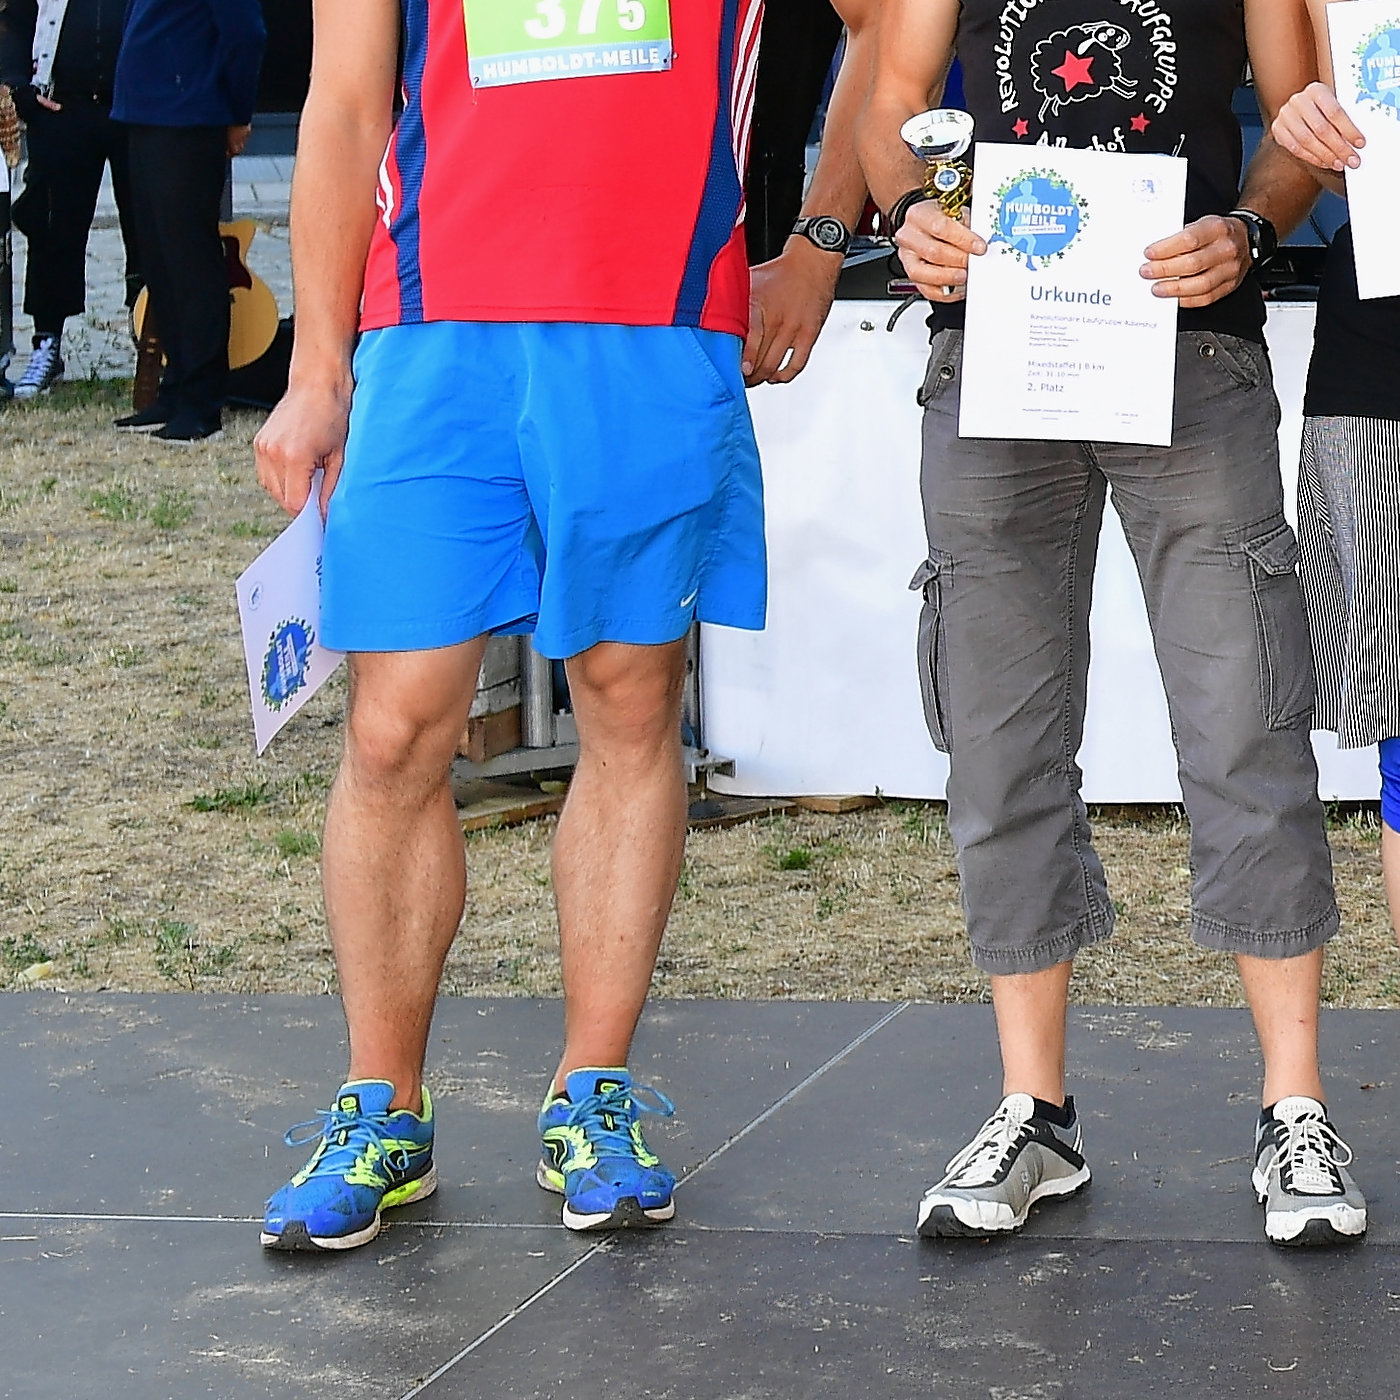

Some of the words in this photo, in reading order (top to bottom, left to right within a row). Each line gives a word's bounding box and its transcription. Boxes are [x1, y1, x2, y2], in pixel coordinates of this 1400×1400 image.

[482, 47, 660, 80] HUMBOLDT-MEILE
[1005, 202, 1074, 217] HUMBOLDT
[1030, 285, 1112, 306] Urkunde
[1027, 382, 1037, 391] 2.
[1040, 382, 1064, 392] Platz
